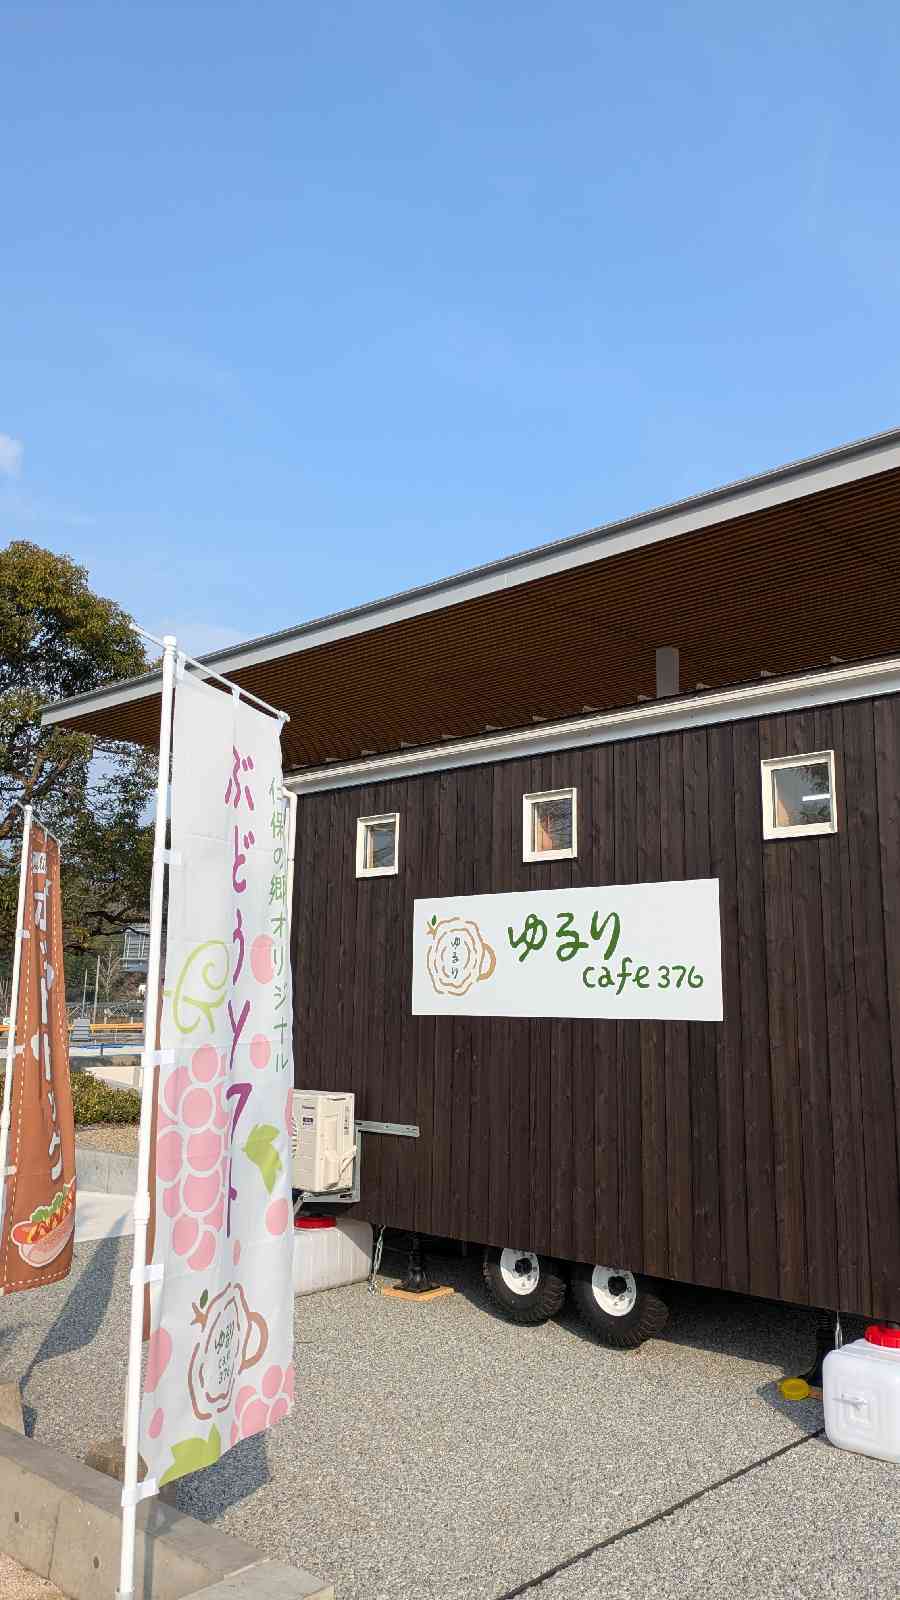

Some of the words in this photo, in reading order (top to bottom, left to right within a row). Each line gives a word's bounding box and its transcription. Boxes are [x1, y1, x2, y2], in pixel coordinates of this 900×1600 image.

[450, 936, 461, 980] ゆるり
[508, 910, 621, 962] ゆるり
[582, 957, 650, 995] cafe
[657, 964, 704, 988] 376
